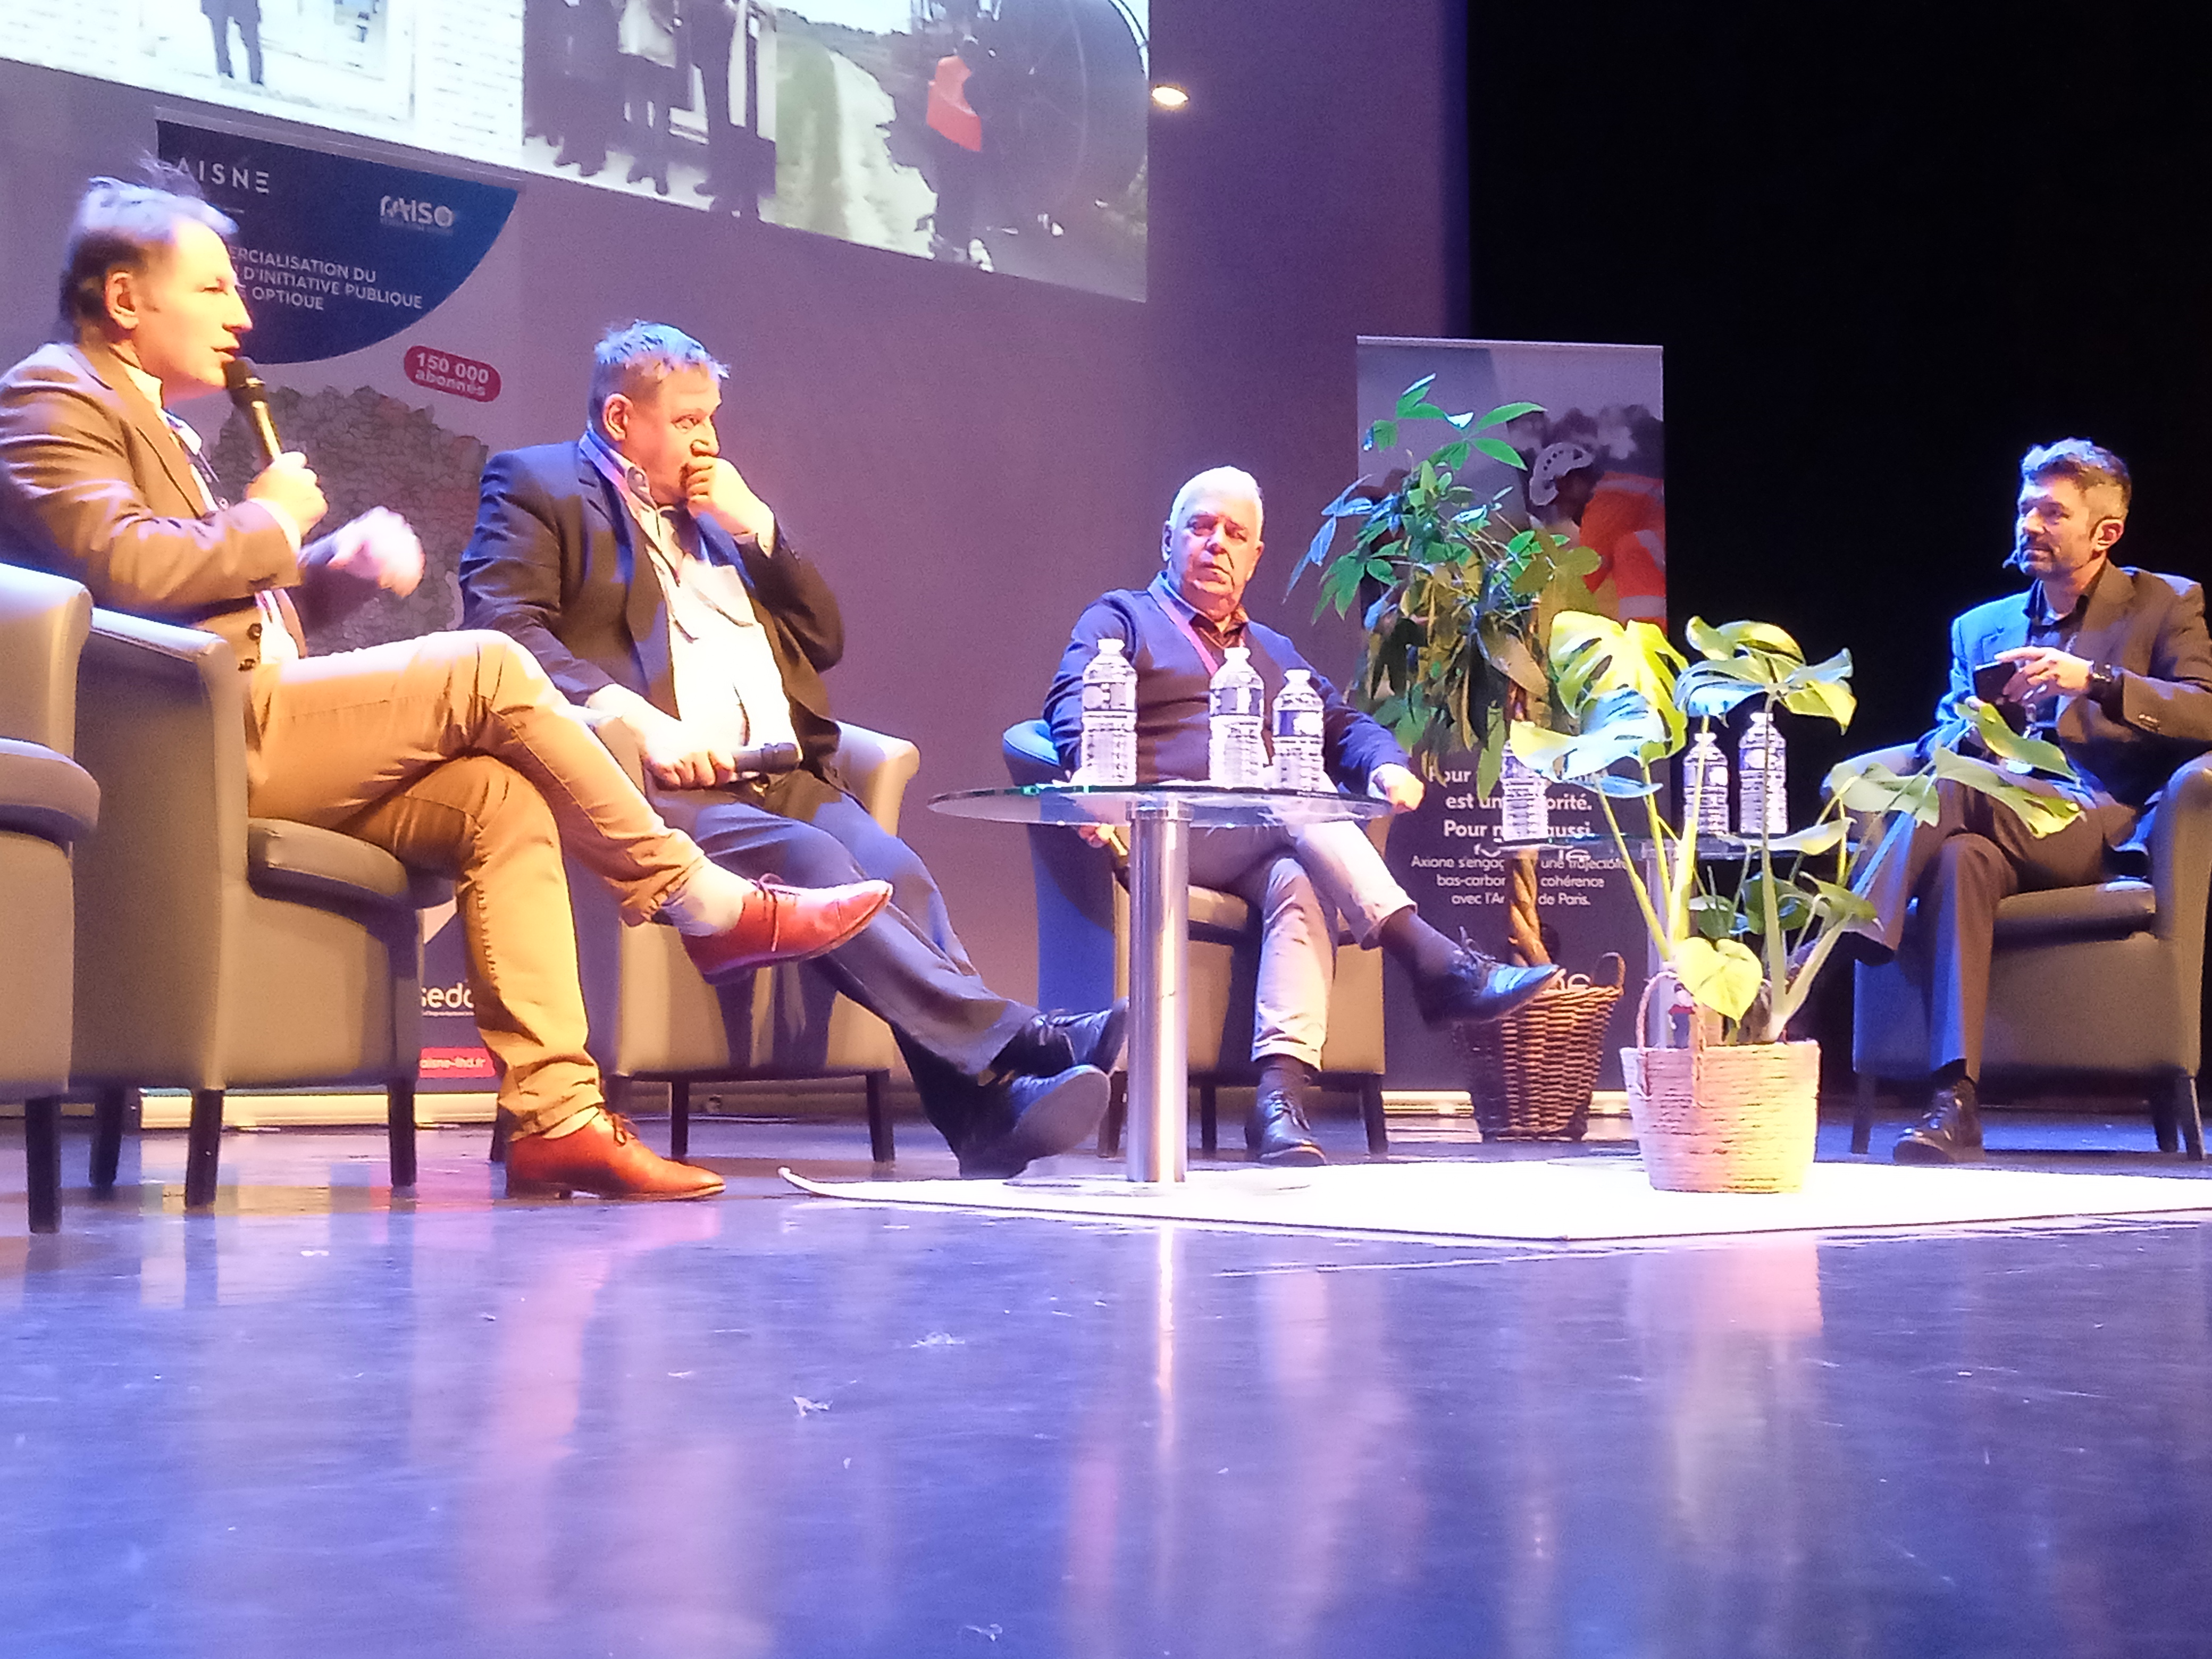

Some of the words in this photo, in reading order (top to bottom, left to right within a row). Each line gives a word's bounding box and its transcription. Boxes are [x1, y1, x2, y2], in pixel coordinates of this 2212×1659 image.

[229, 245, 348, 279] ERCIALISATION
[354, 267, 376, 283] DU
[244, 266, 339, 295] D'INITIATIVE
[345, 282, 423, 309] PUBLIQUE
[417, 353, 450, 373] 150
[455, 363, 489, 384] 000
[1445, 793, 1474, 809] est
[1546, 793, 1592, 811] orité.
[1444, 819, 1488, 837] Pour
[1411, 855, 1455, 868] Axione
[1540, 875, 1605, 887] cohérence
[1451, 895, 1482, 904] avec
[1538, 893, 1555, 905] de
